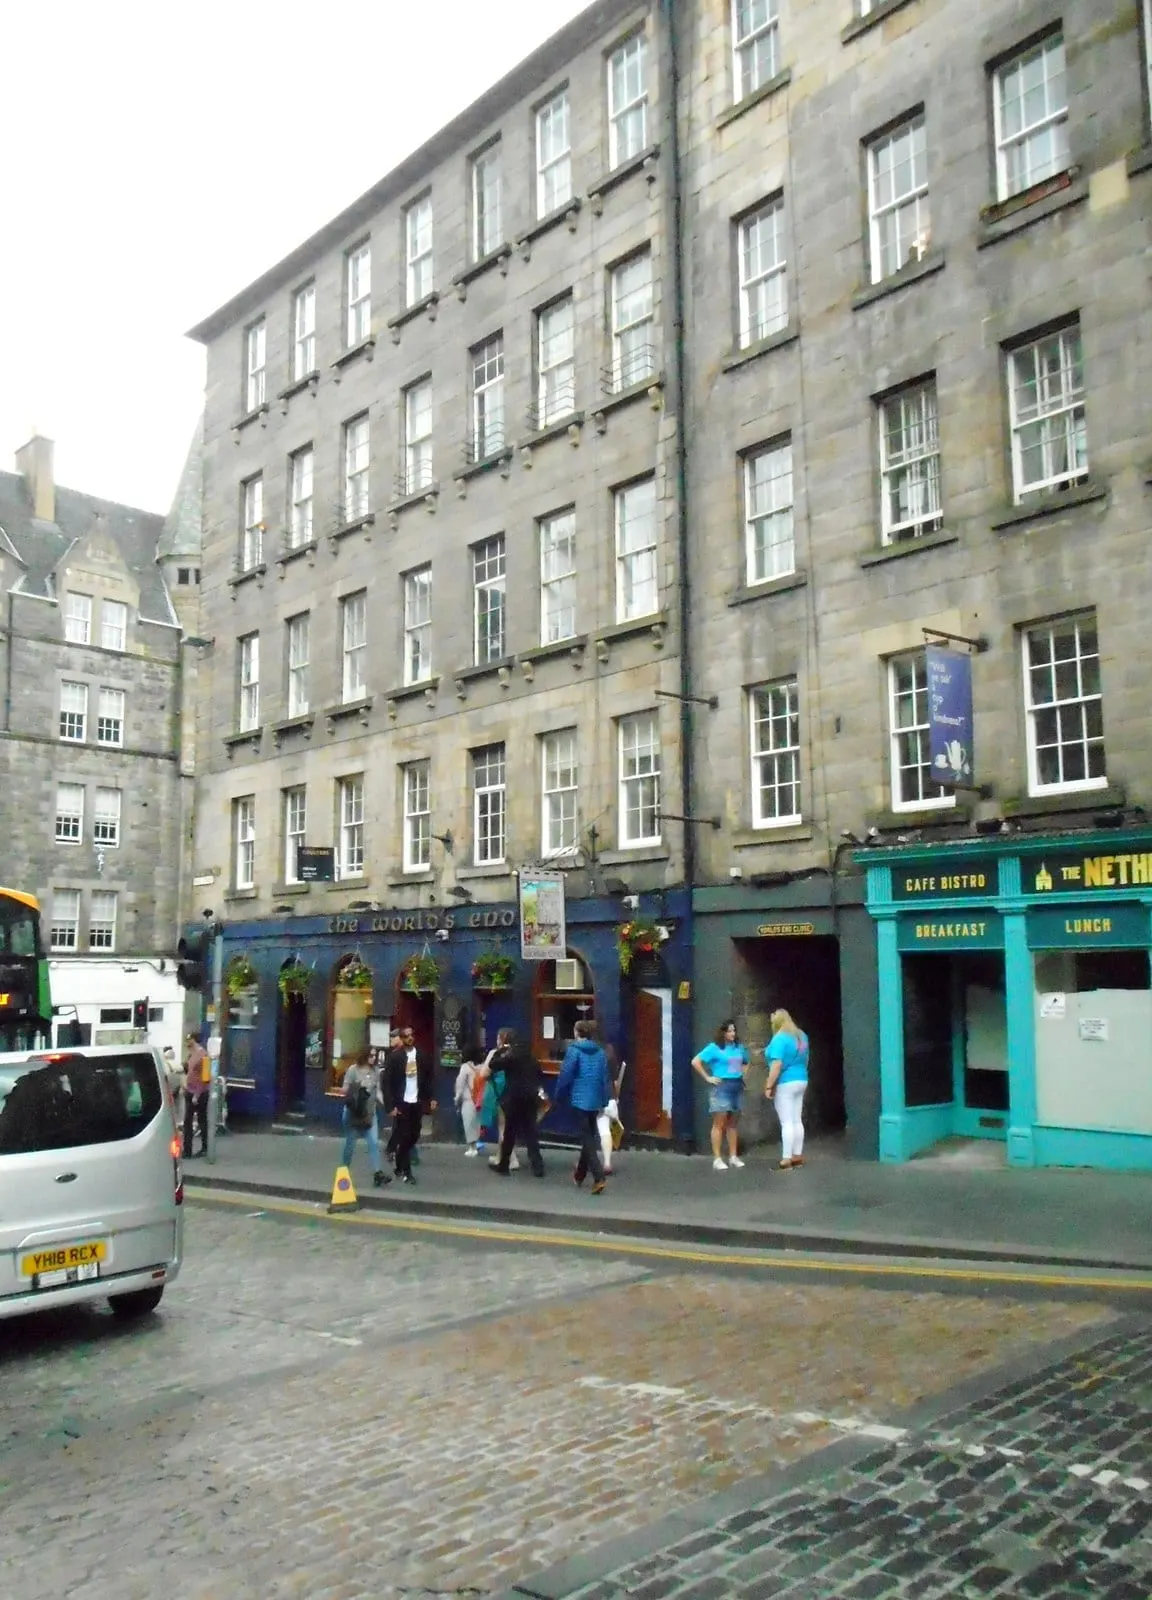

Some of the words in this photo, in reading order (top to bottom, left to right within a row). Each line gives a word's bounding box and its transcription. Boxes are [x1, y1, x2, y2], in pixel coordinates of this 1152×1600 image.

[1061, 866, 1081, 880] THE
[1083, 853, 1152, 887] NETH
[906, 877, 936, 892] CAFE
[941, 874, 986, 890] BISTRO
[915, 923, 986, 938] BREAKFAST
[1065, 918, 1112, 933] LUNCH
[33, 1251, 66, 1269] YH18
[70, 1244, 98, 1261] RCX
